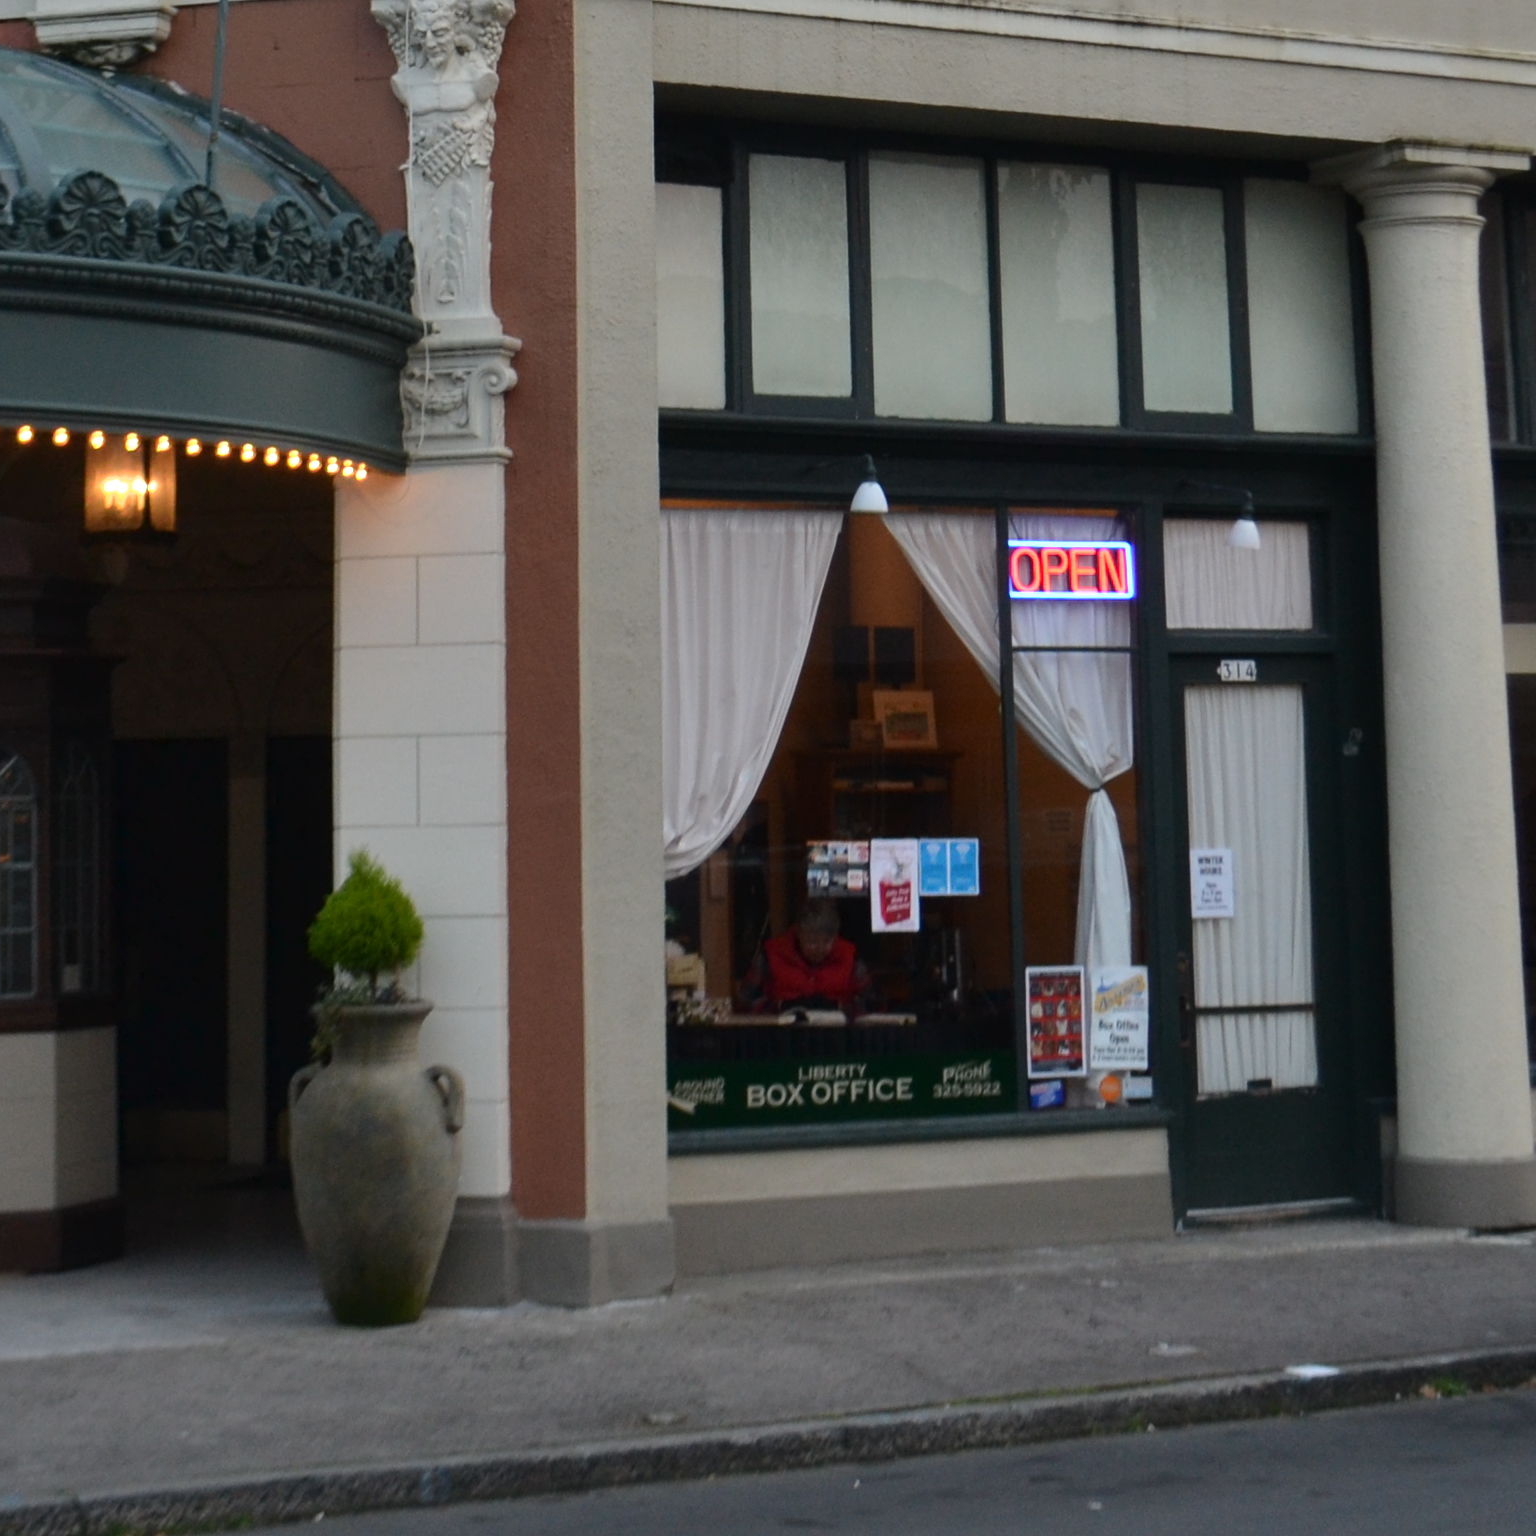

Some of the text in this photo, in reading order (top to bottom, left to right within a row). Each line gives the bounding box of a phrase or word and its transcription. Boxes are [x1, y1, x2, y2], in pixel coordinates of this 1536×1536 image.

[1009, 546, 1128, 594] OPEN
[1223, 662, 1254, 679] 314
[798, 1063, 867, 1081] LIBERTY
[746, 1076, 913, 1109] BOX OFFICE
